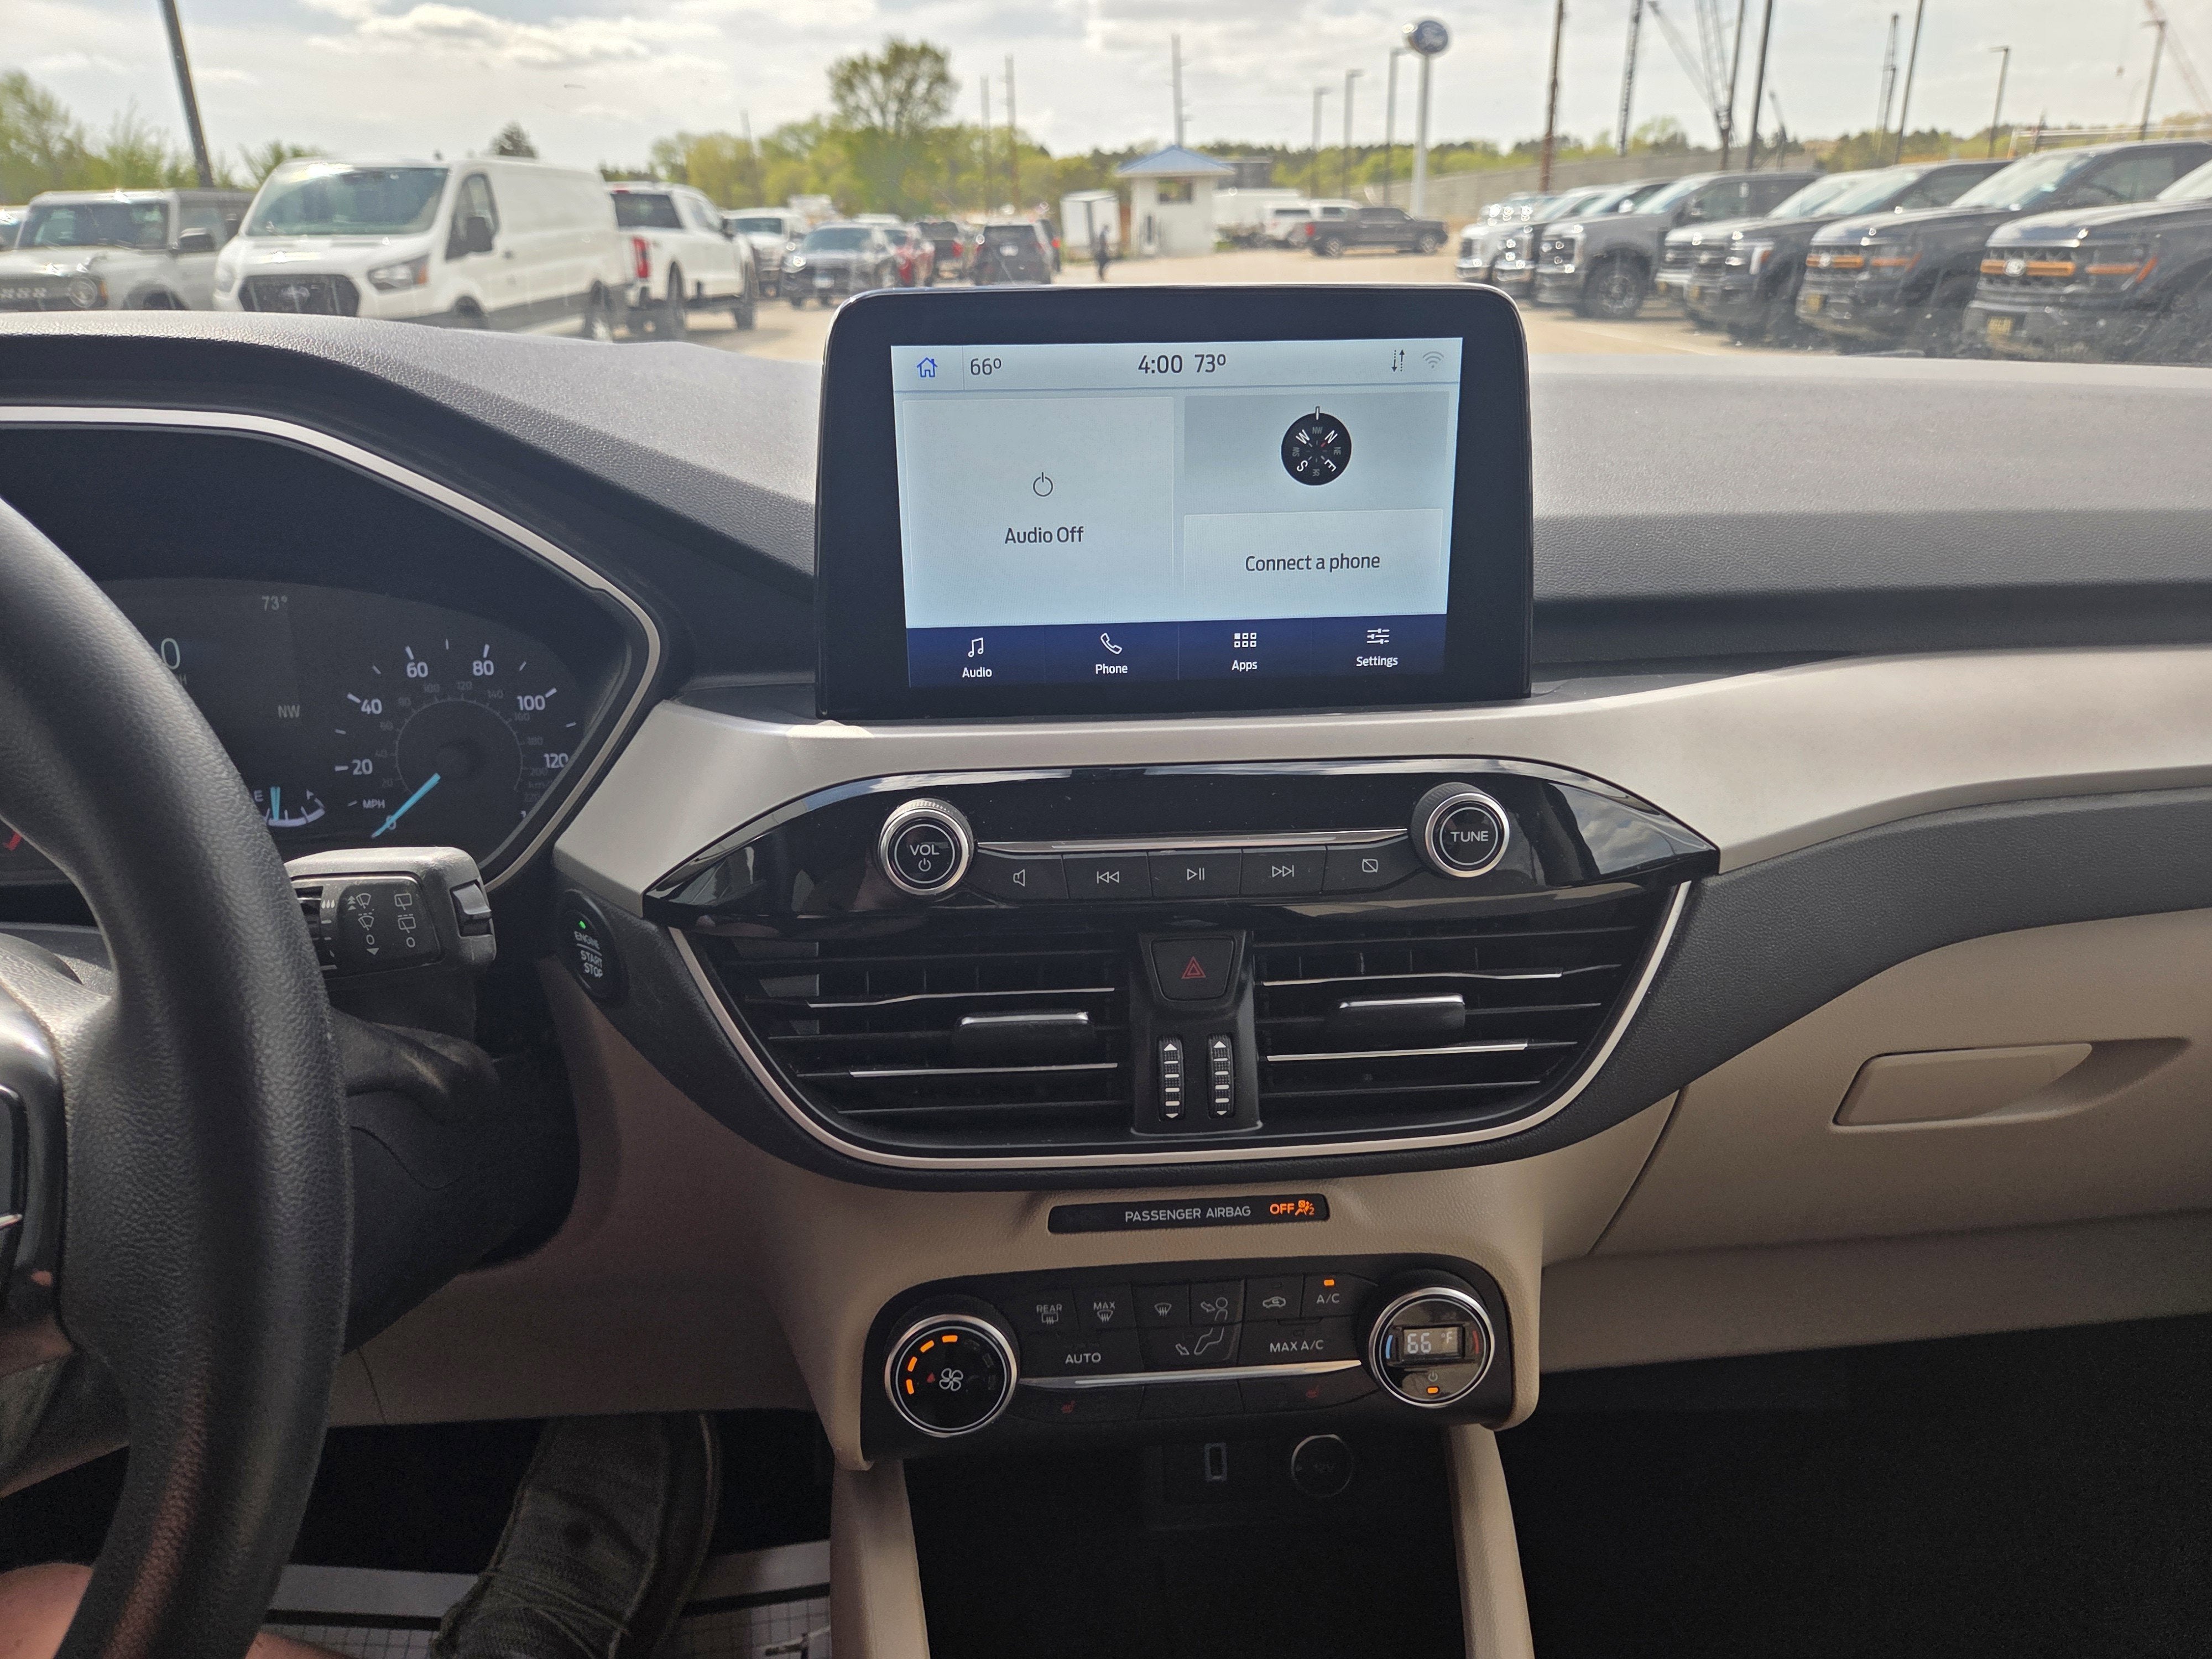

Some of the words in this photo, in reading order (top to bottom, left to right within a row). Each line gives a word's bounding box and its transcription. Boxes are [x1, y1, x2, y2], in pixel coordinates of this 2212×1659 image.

[1138, 354, 1183, 374] 4:00
[1295, 429, 1310, 444] W
[1324, 430, 1338, 444] N
[1296, 460, 1308, 472] S
[1324, 459, 1337, 472] E
[1004, 528, 1053, 544] Audio
[1056, 526, 1084, 543] Off
[1245, 554, 1312, 572] Connect
[1316, 559, 1326, 570] a
[1329, 553, 1381, 572] phone
[161, 638, 180, 670] 0
[472, 660, 494, 676] 80
[1232, 660, 1258, 672] Apps
[1356, 656, 1399, 667] Settings
[406, 661, 429, 678] 60
[962, 667, 993, 678] Audio
[1095, 664, 1129, 675] Phone
[361, 698, 383, 714] 40
[517, 695, 546, 711] 100
[278, 705, 300, 718] NW
[352, 758, 373, 775] 20
[543, 753, 569, 768] 120
[254, 790, 264, 802] E
[362, 799, 385, 808] MPH
[1450, 831, 1489, 842] TUNE
[910, 844, 940, 855] VOL
[581, 950, 602, 968] START
[583, 962, 603, 978] STOP
[1125, 1208, 1202, 1223] PASSENGER
[1206, 1205, 1251, 1218] AIRBAG
[1270, 1203, 1295, 1214] OFF
[1093, 1301, 1115, 1310] MAX
[1316, 1293, 1340, 1304] A/C
[1036, 1303, 1063, 1313] REAR
[1270, 1341, 1298, 1353] MAX
[1301, 1339, 1324, 1351] A/C
[1407, 1332, 1432, 1354] 66
[1065, 1352, 1102, 1364] AUTO
